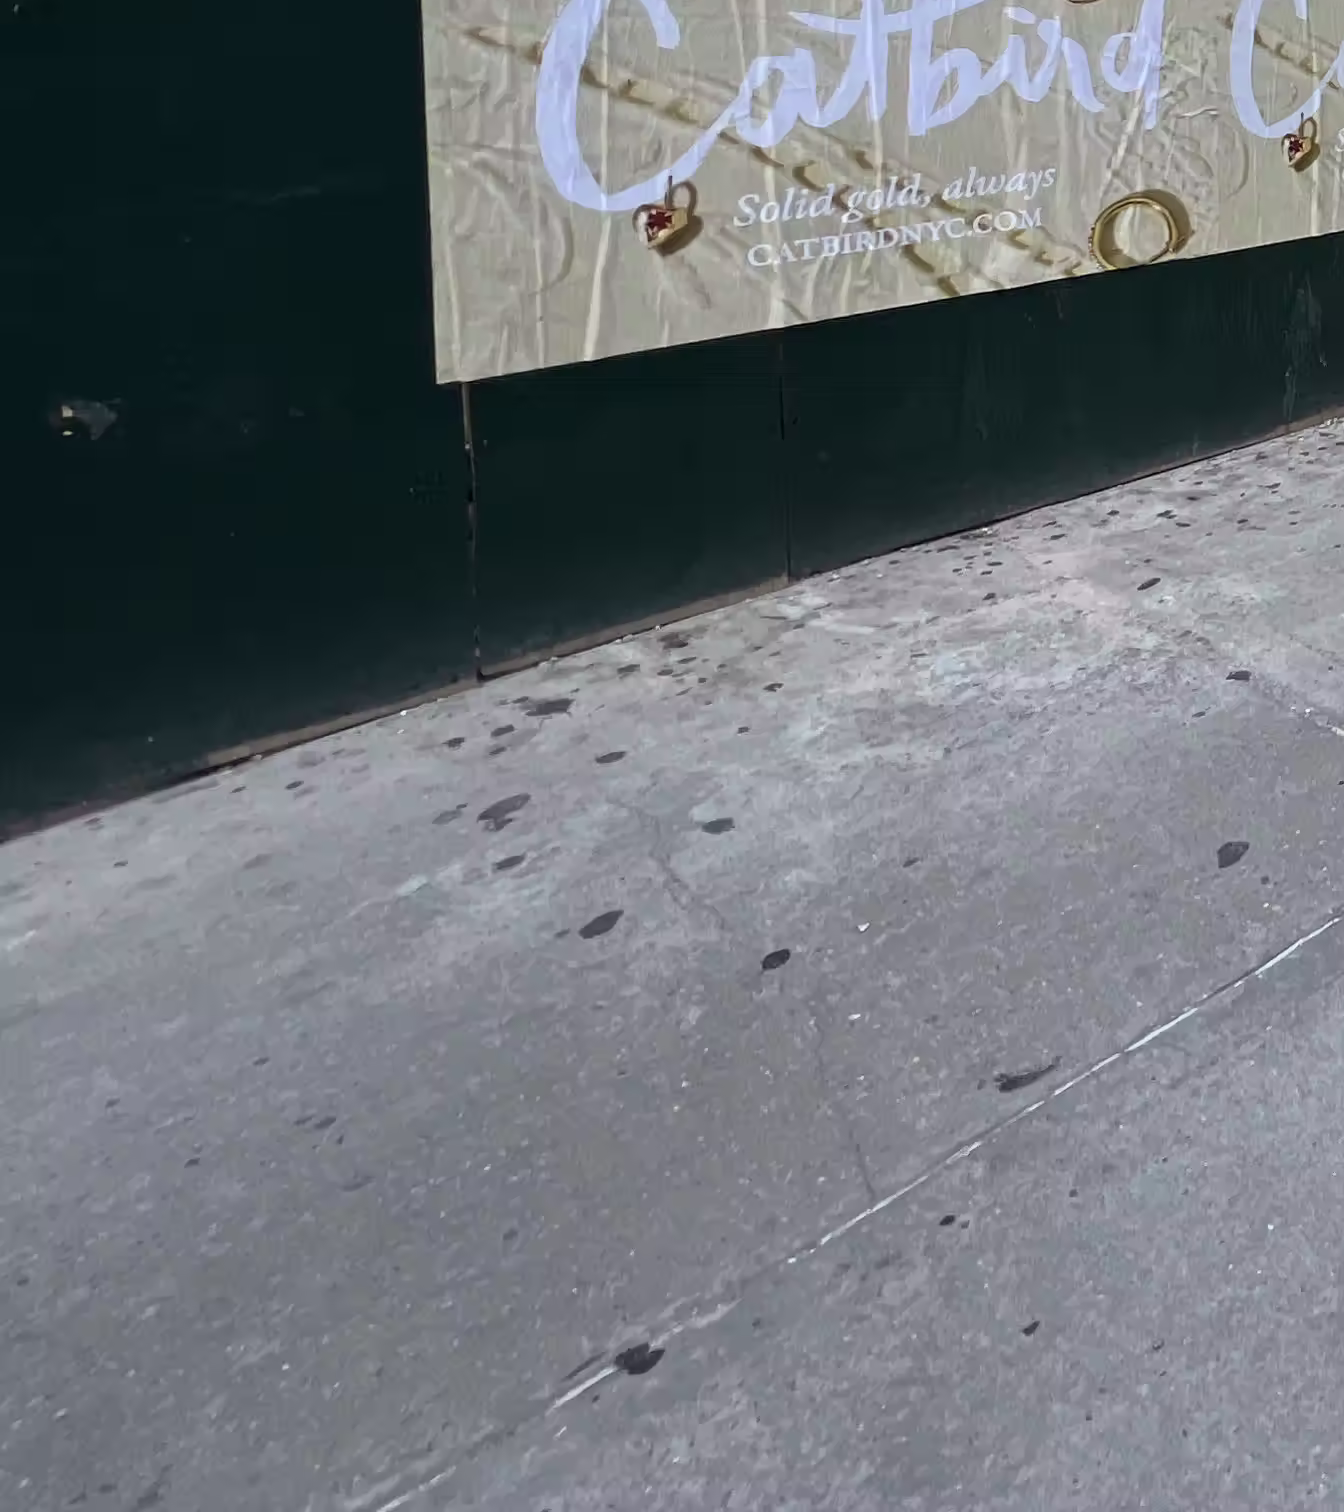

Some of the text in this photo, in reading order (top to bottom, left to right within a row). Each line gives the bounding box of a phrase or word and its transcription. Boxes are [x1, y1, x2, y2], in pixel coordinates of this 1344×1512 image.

[733, 166, 1056, 227] Solid gold, always
[747, 207, 1042, 267] CATBIRDNYC.COM
